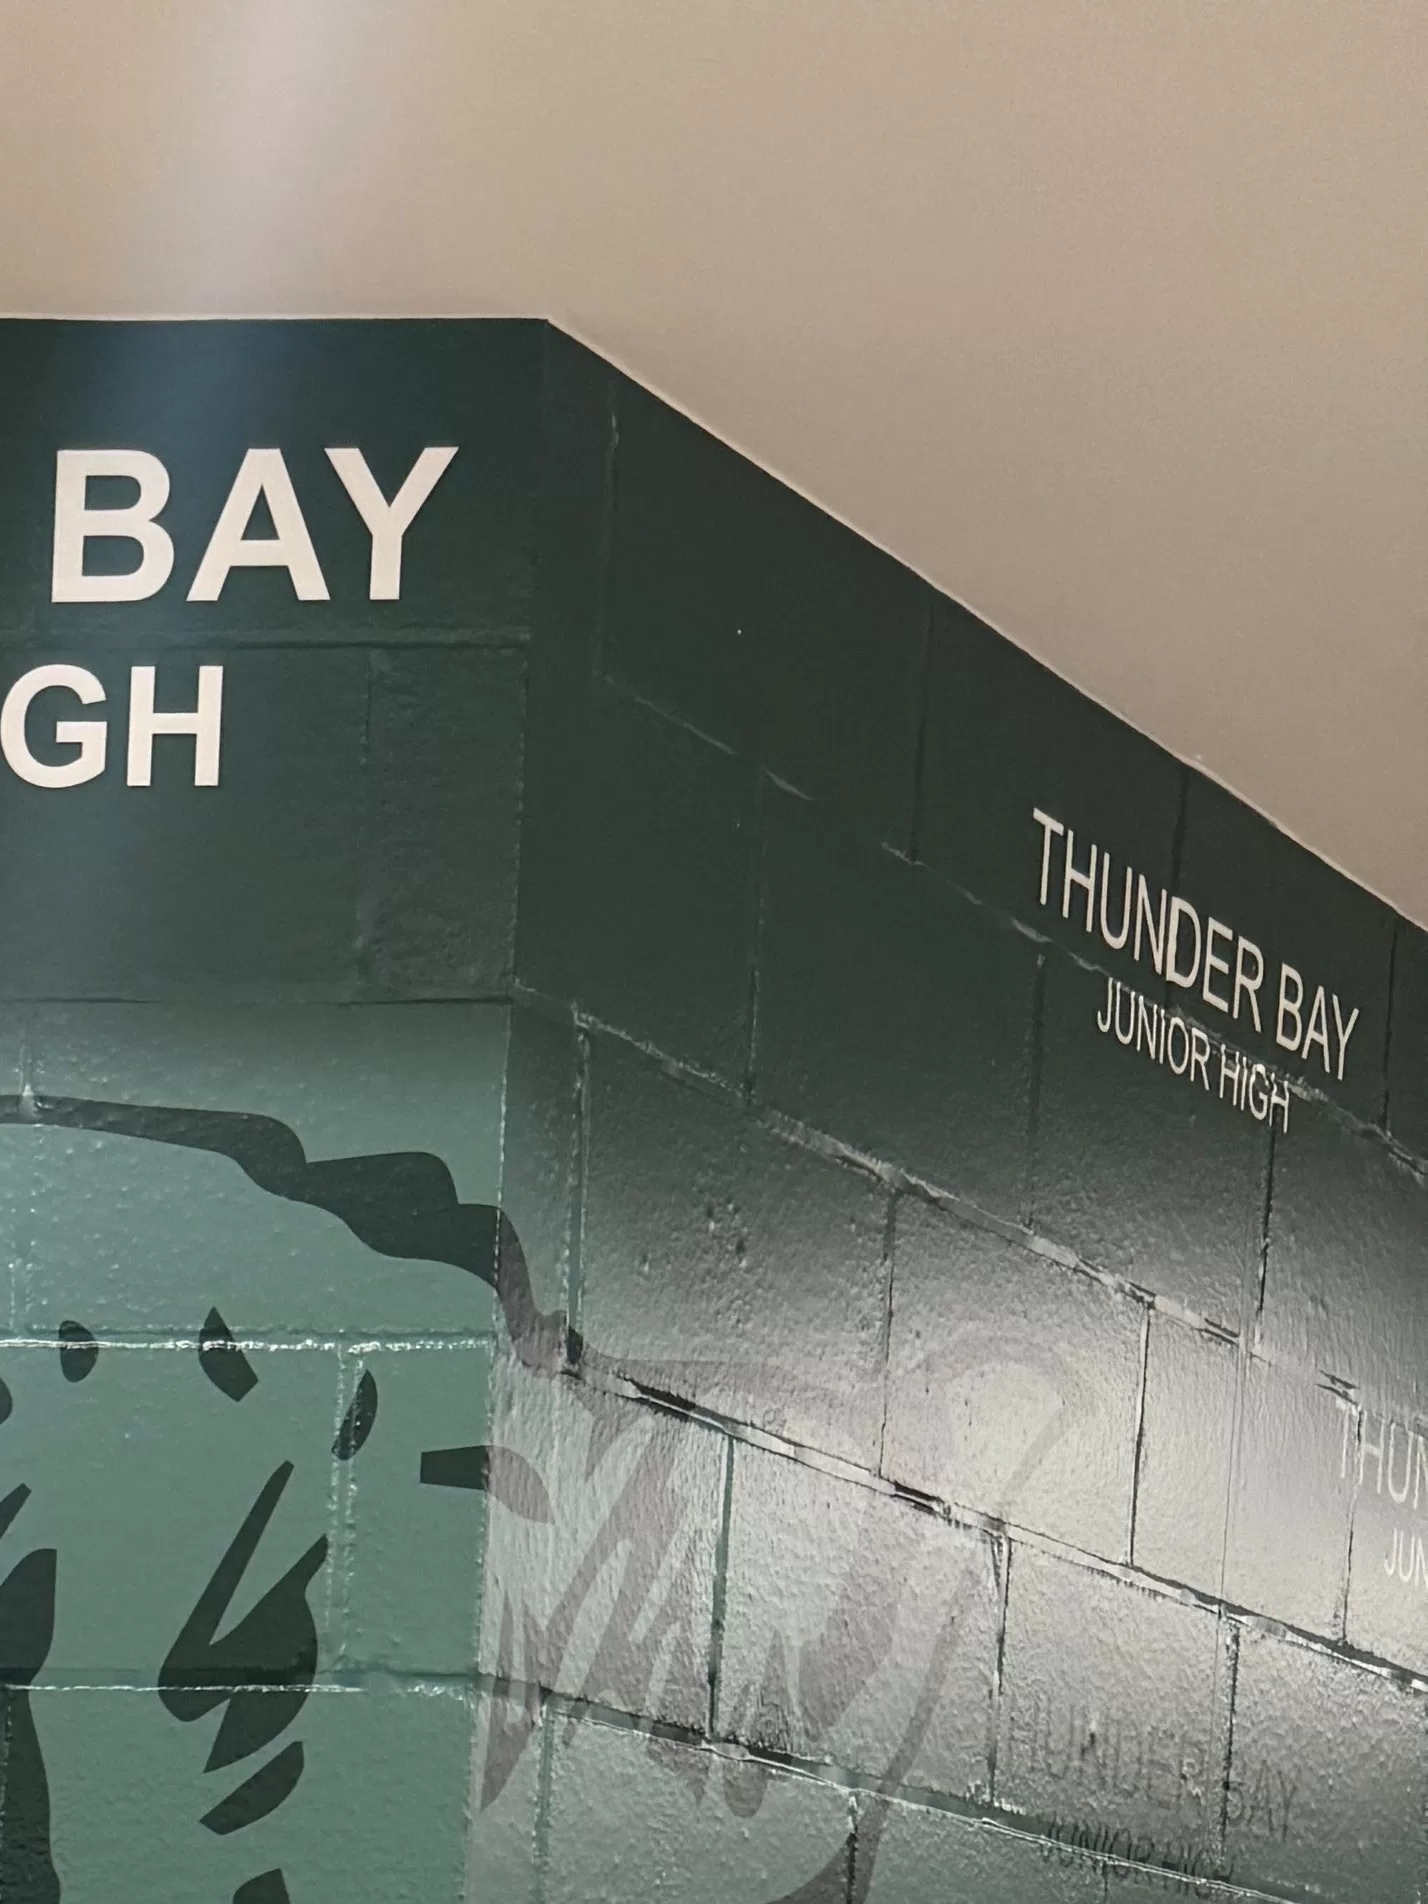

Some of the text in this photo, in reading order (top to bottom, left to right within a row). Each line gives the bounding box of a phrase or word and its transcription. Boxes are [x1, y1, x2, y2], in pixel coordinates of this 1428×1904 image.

[50, 445, 459, 603] BAY
[1033, 807, 1359, 1081] THUNDER BAY
[1096, 977, 1290, 1133] JUNIOR HIGH
